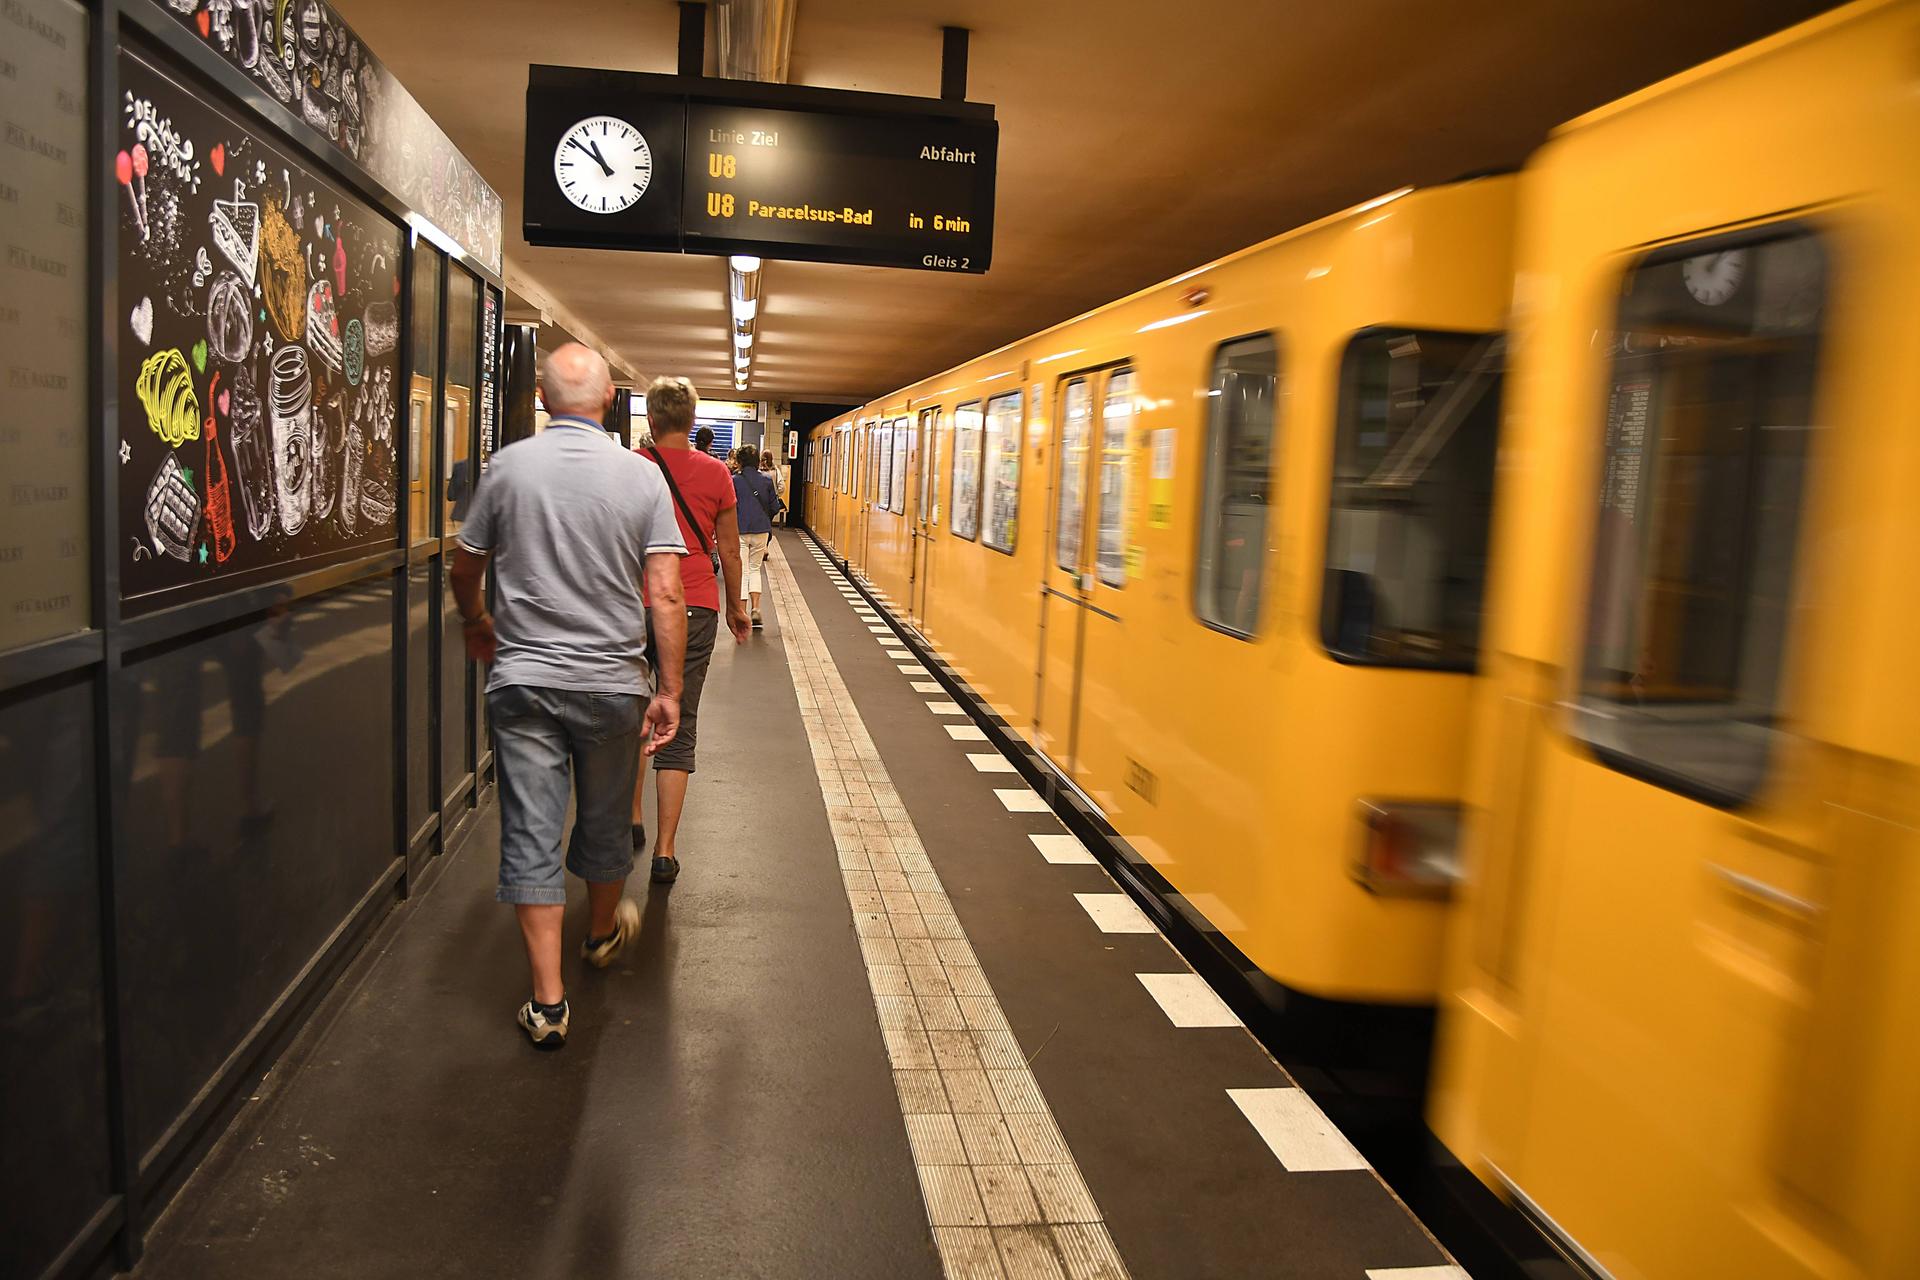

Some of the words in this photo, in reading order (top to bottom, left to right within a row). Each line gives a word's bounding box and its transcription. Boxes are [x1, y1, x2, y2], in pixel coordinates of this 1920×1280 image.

[30, 134, 67, 164] BAKERY
[133, 98, 194, 183] DELICIOUS
[709, 128, 745, 145] Linie
[751, 131, 779, 147] Ziel
[920, 145, 976, 164] Abfahrt
[708, 152, 737, 179] U8
[706, 191, 735, 218] U8
[748, 200, 873, 226] Paracelsus-Bad
[909, 212, 924, 229] in
[31, 254, 67, 278] BAKERY
[922, 254, 958, 269] Gleis
[960, 257, 970, 270] 2
[31, 371, 68, 391] BAKERY
[33, 486, 69, 503] BAKERY
[35, 594, 72, 613] BAKERY
